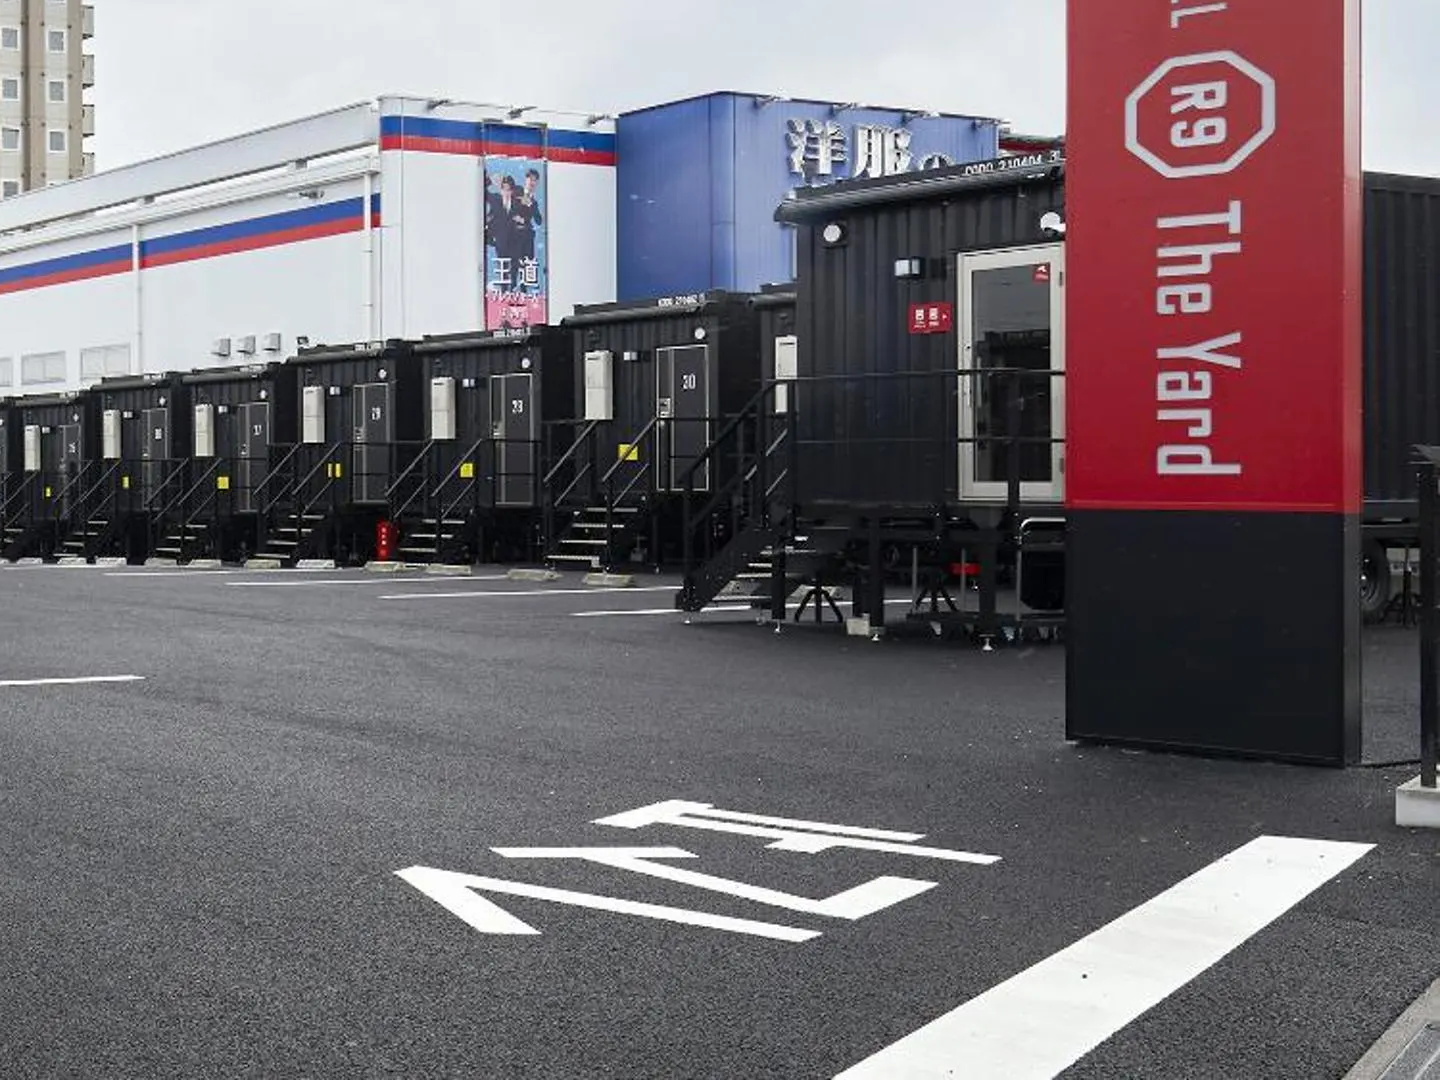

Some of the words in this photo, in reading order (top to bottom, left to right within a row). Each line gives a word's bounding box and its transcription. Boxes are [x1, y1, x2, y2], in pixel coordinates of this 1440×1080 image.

[1169, 79, 1229, 149] R9
[491, 257, 539, 288] 王道
[1155, 199, 1242, 316] The
[1155, 331, 1243, 476] Yard
